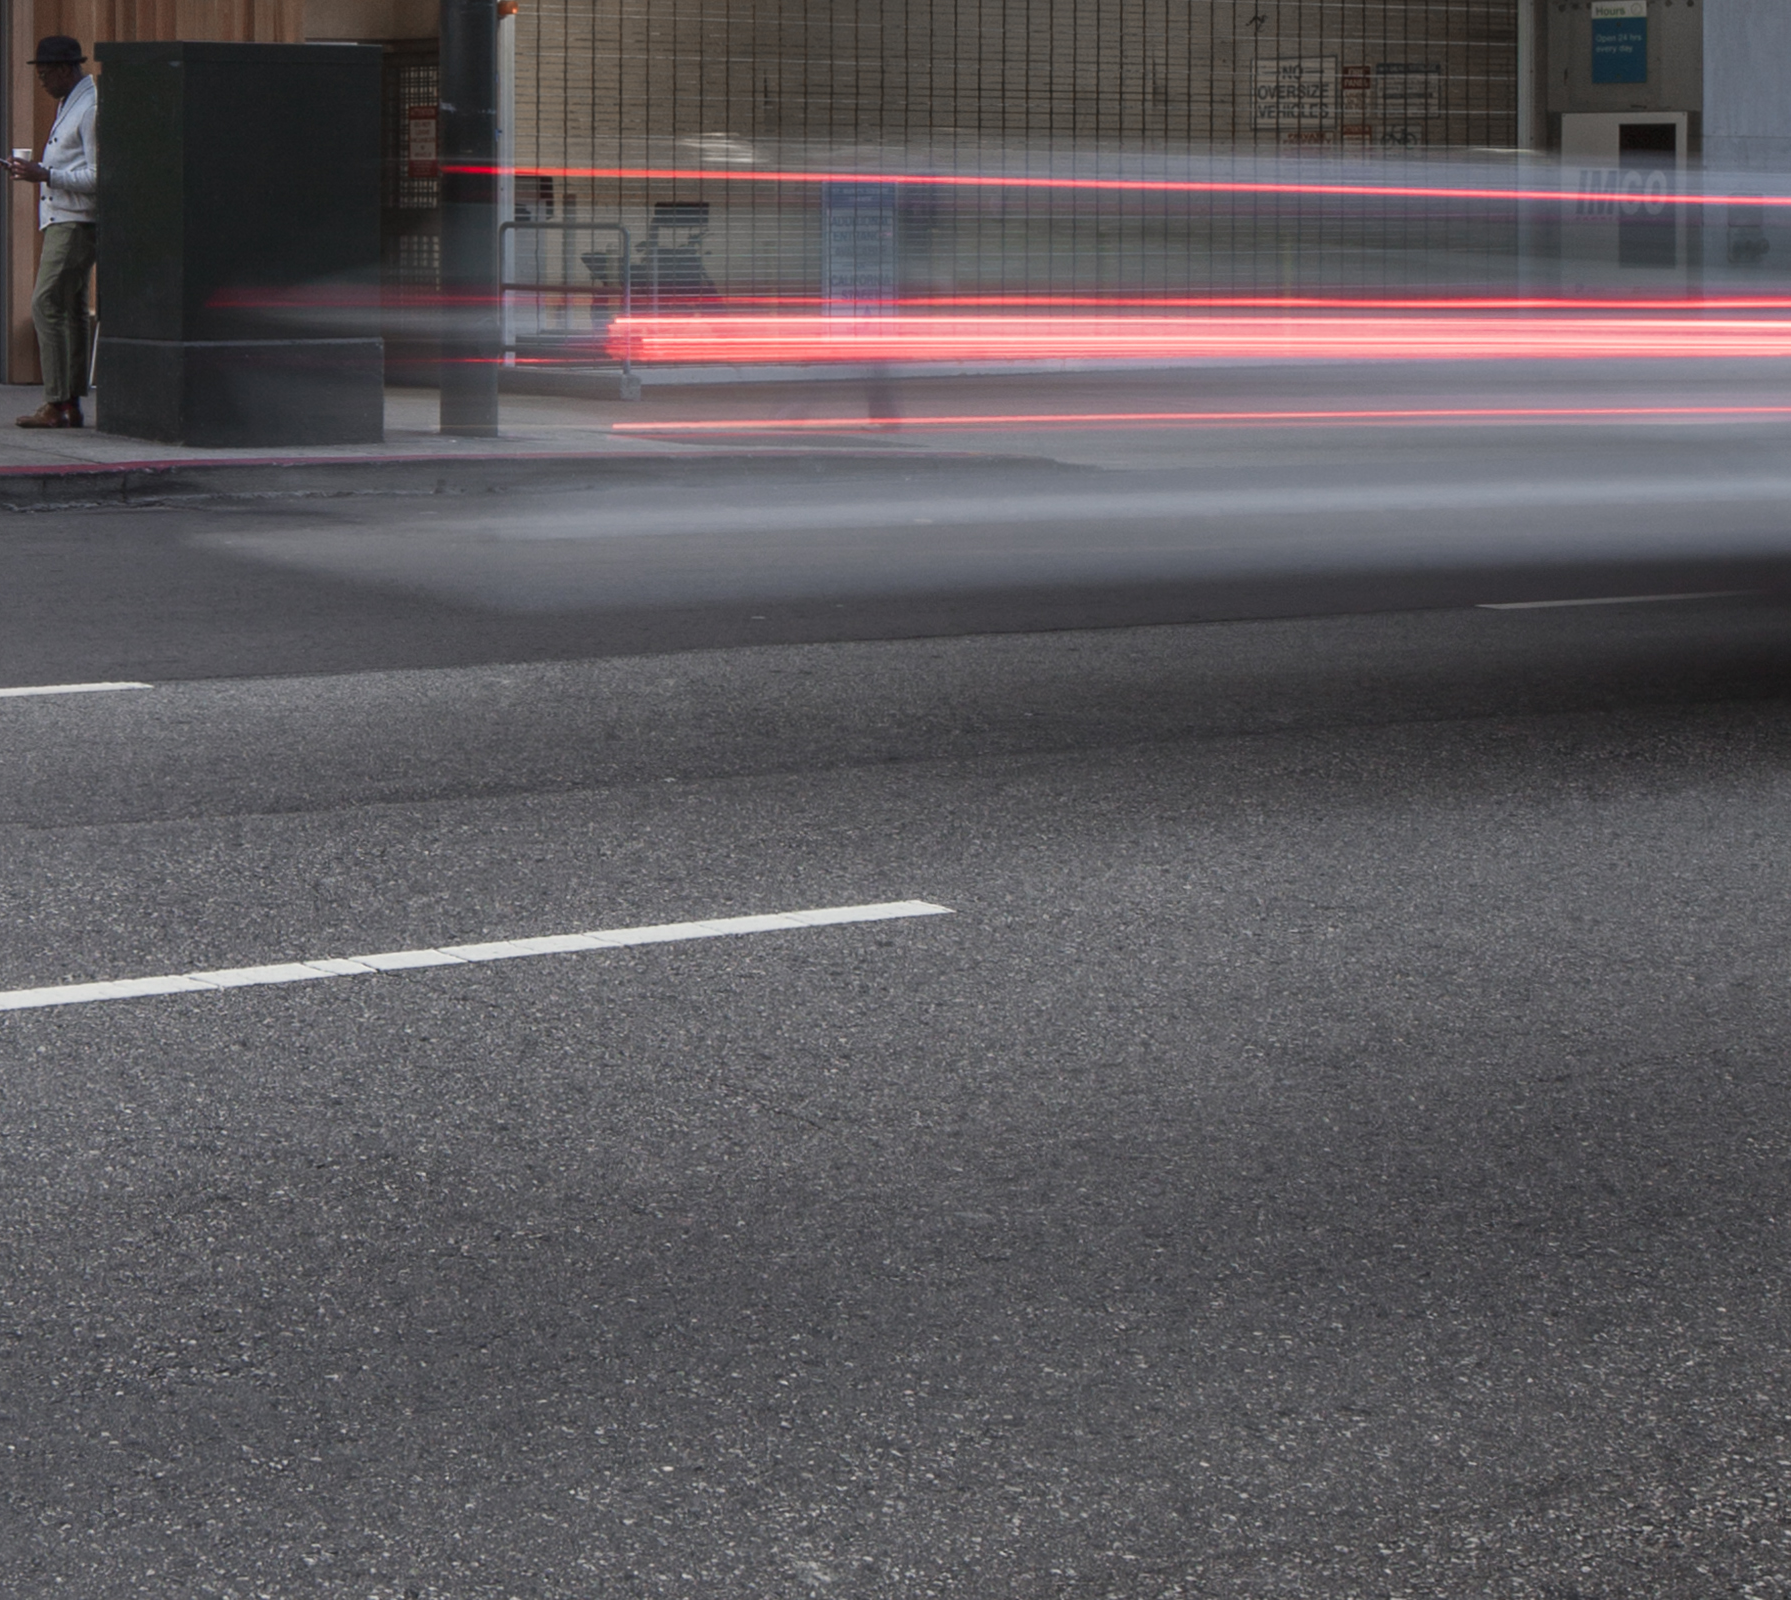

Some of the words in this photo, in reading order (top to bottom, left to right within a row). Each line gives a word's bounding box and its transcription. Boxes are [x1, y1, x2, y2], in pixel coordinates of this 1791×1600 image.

[1595, 6, 1626, 16] Hours
[1282, 64, 1303, 80] NO
[1258, 83, 1329, 99] OVERSIZE
[1258, 103, 1329, 119] VEHICLES
